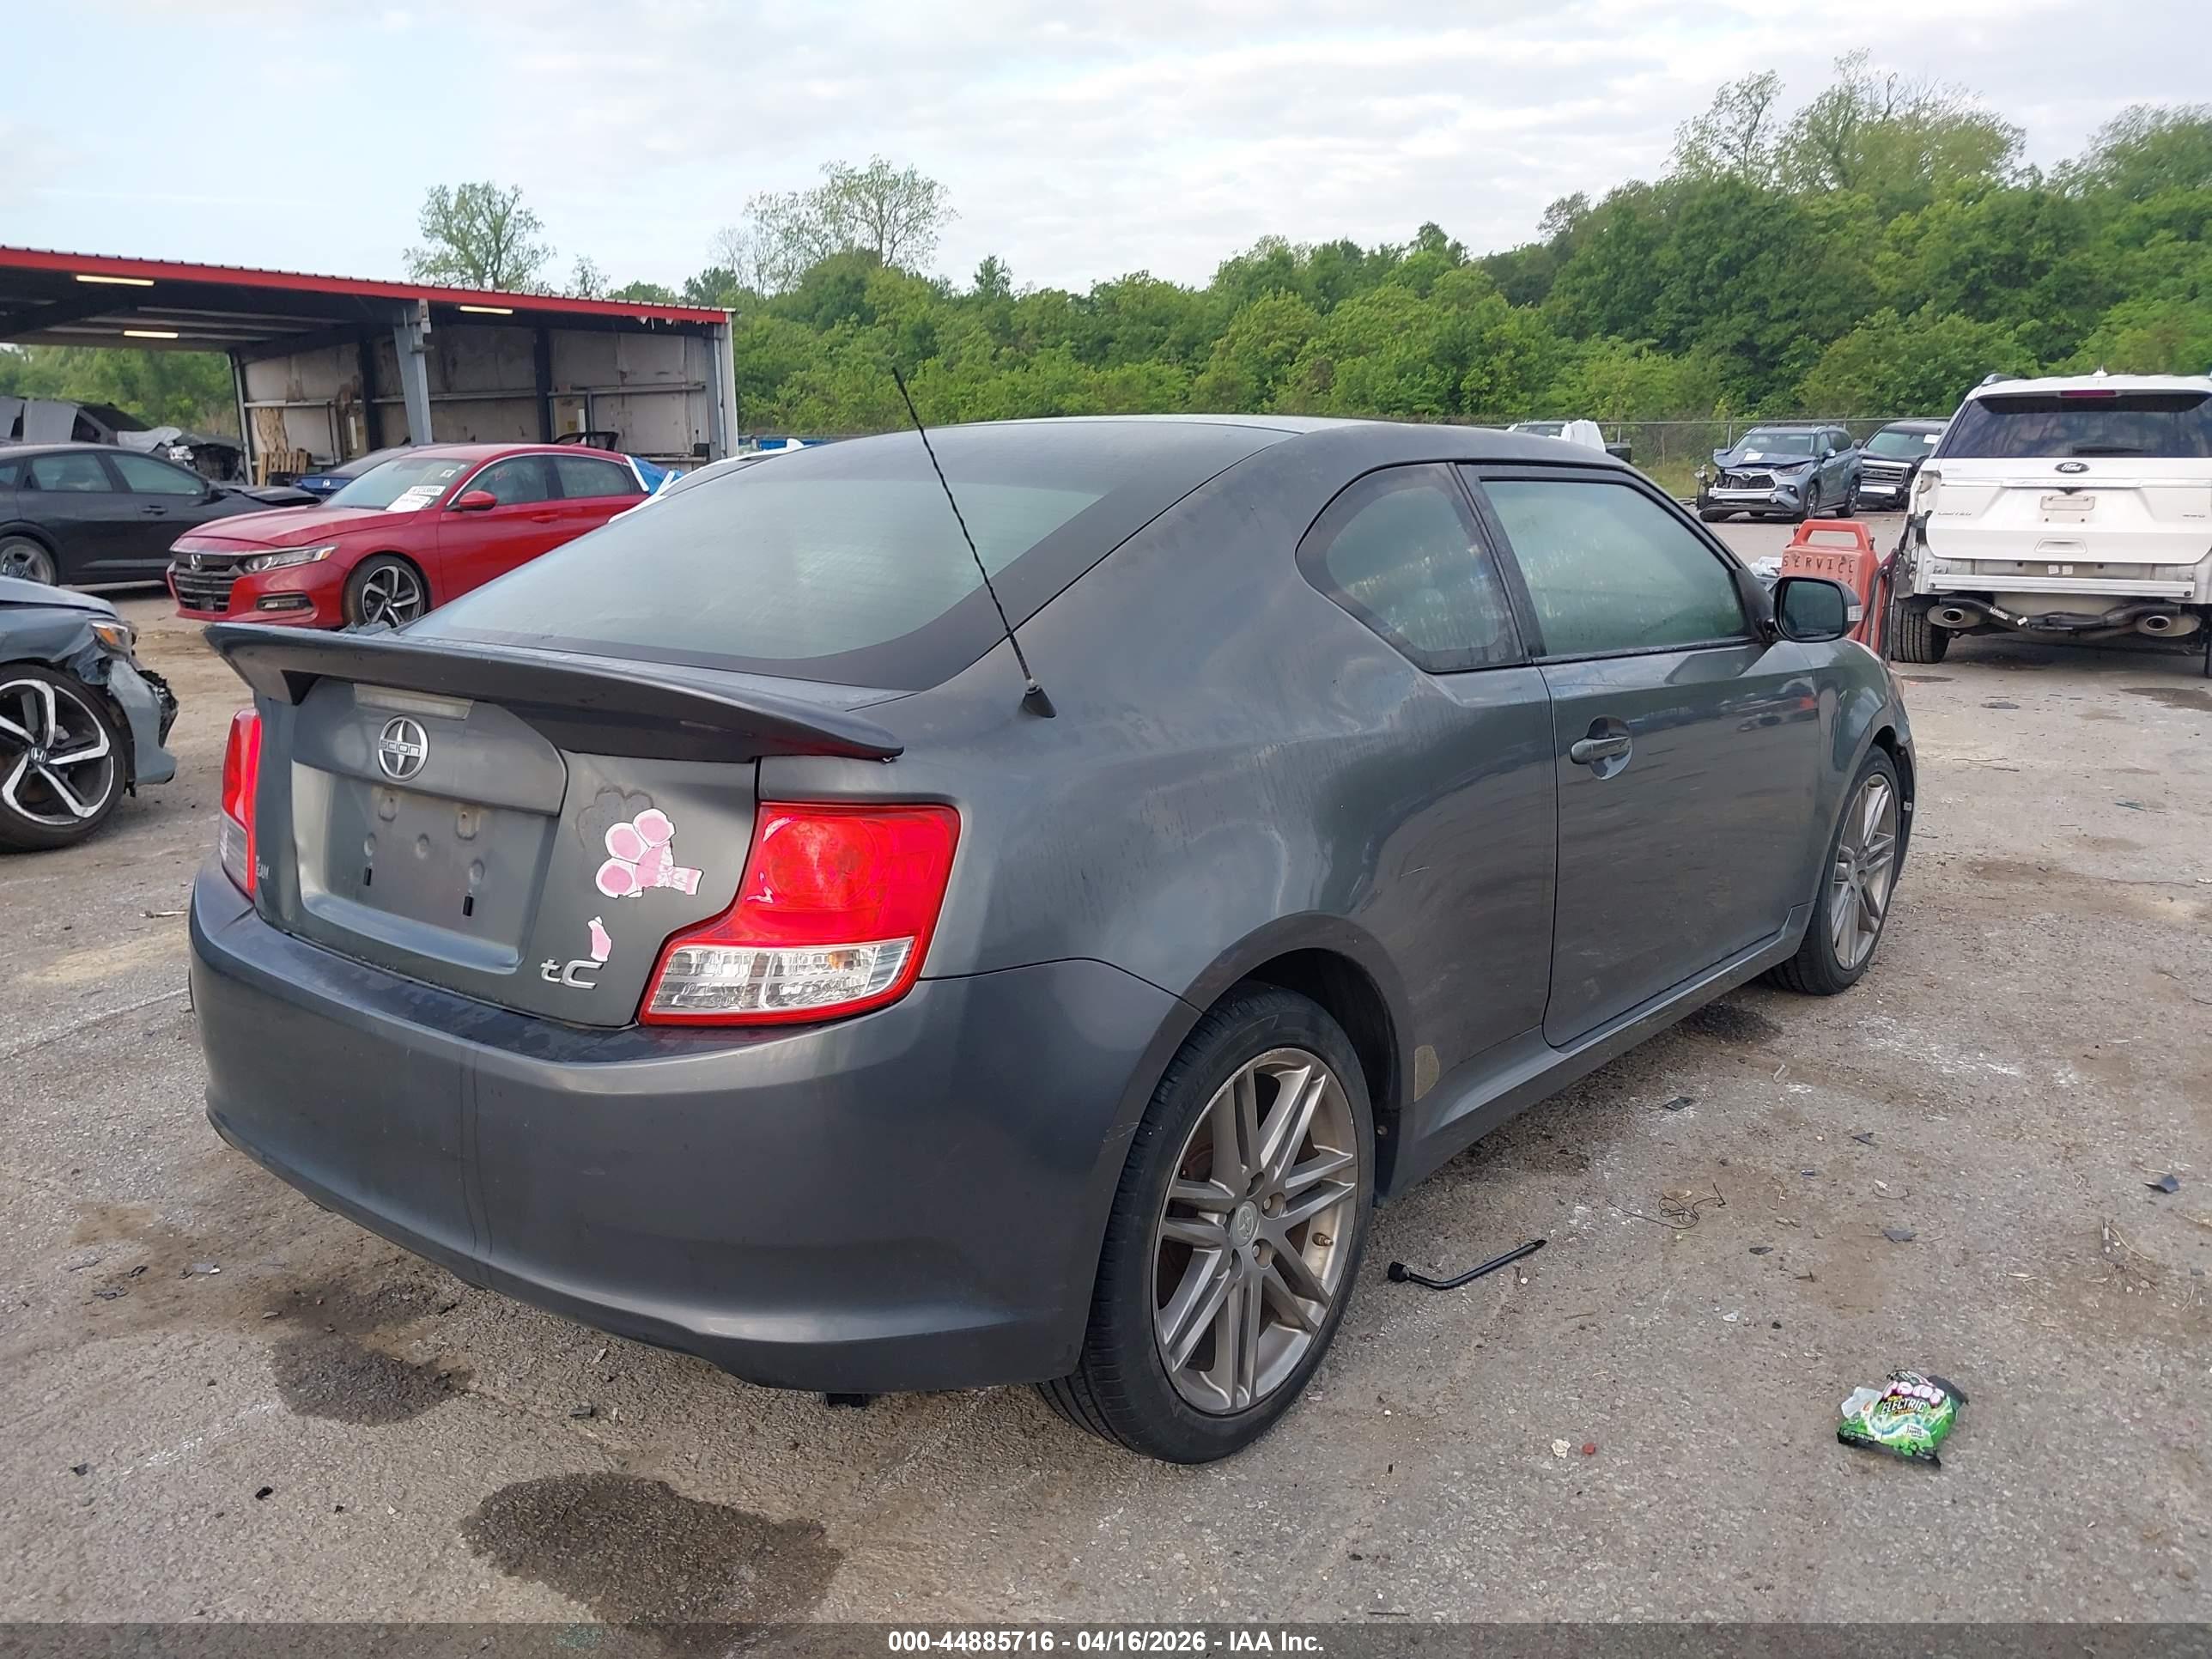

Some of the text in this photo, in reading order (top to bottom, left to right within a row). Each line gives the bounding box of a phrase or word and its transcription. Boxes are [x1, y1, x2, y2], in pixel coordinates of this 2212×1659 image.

[1782, 552, 1856, 574] SERVICE
[379, 739, 421, 757] SCION
[540, 958, 605, 989] tC
[1881, 1398, 1926, 1414] ELECTRIC
